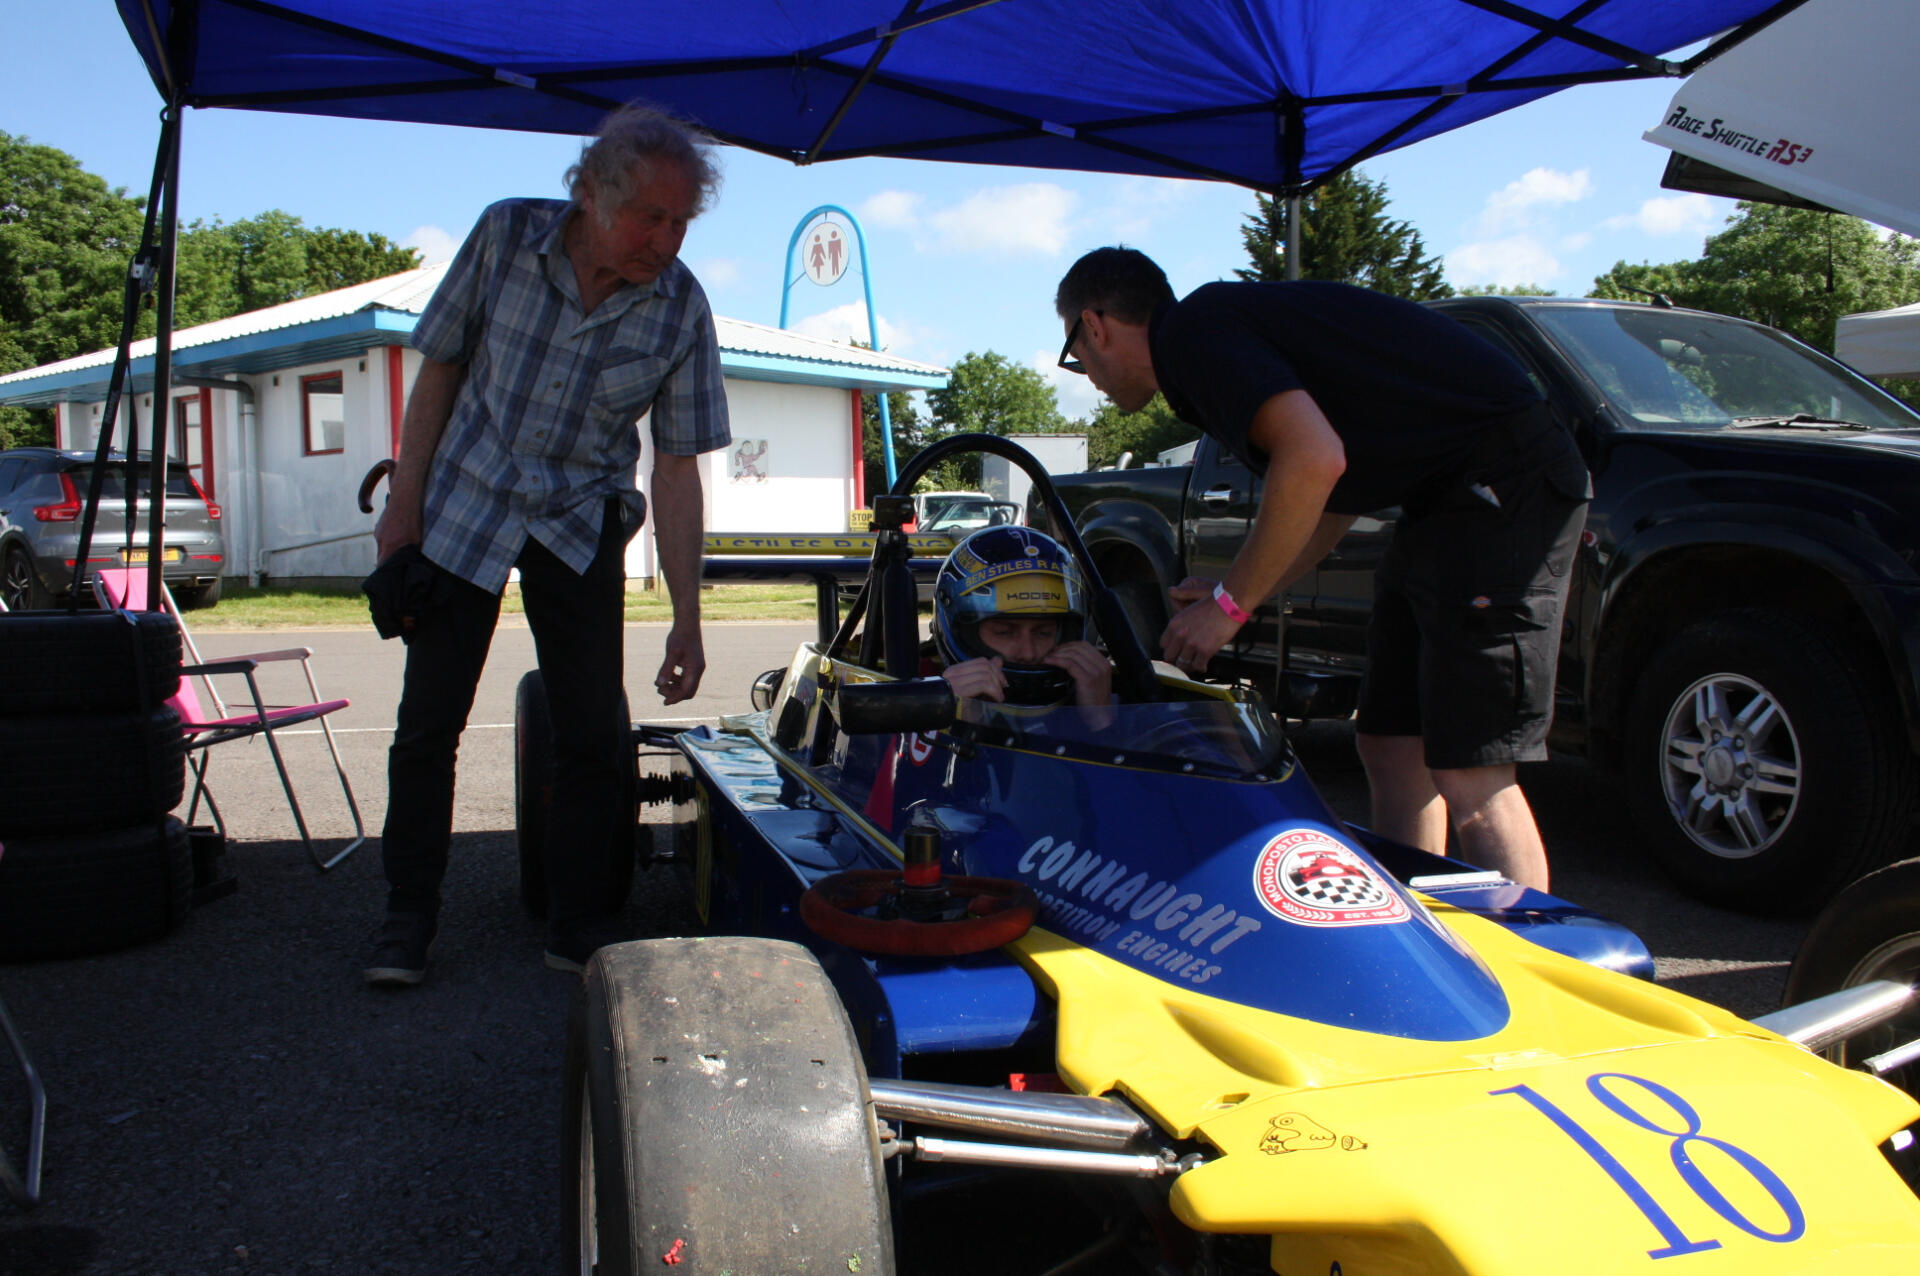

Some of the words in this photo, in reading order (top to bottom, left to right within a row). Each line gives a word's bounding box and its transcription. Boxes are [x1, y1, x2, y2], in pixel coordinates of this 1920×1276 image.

[851, 513, 873, 521] STOP
[965, 568, 987, 588] BEN
[988, 560, 1033, 577] STILES
[1018, 835, 1262, 955] CONNAUGHT
[1263, 834, 1303, 903] MONOPOSTO
[1116, 930, 1222, 984] ENGINES
[1487, 1072, 1806, 1261] 18
